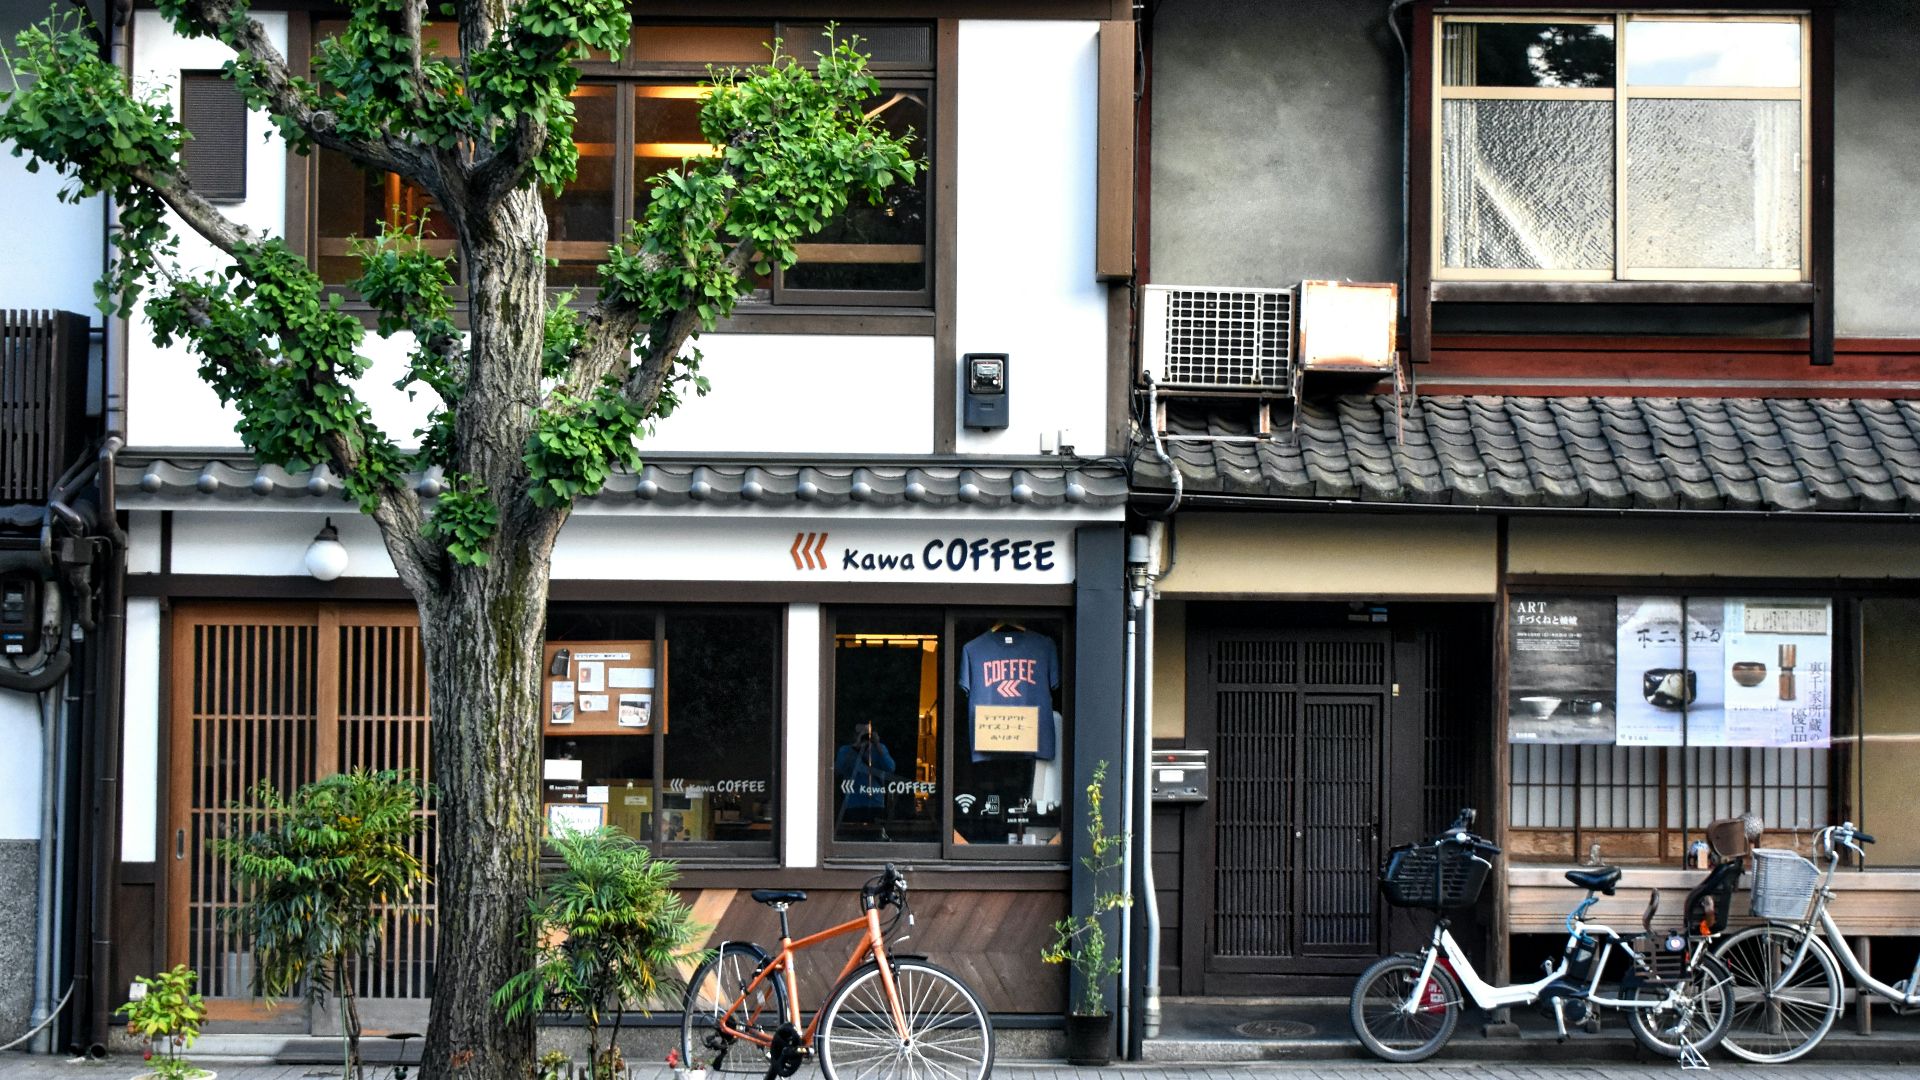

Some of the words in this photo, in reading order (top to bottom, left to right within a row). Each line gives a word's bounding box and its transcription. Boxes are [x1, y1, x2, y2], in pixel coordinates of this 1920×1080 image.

[843, 548, 914, 570] Kawa
[923, 537, 1055, 571] COFFEE
[1517, 601, 1547, 613] ART
[983, 659, 1037, 687] COFFEE
[717, 779, 766, 793] COFFEE
[859, 784, 886, 794] Kawa
[888, 780, 937, 794] COFFEE
